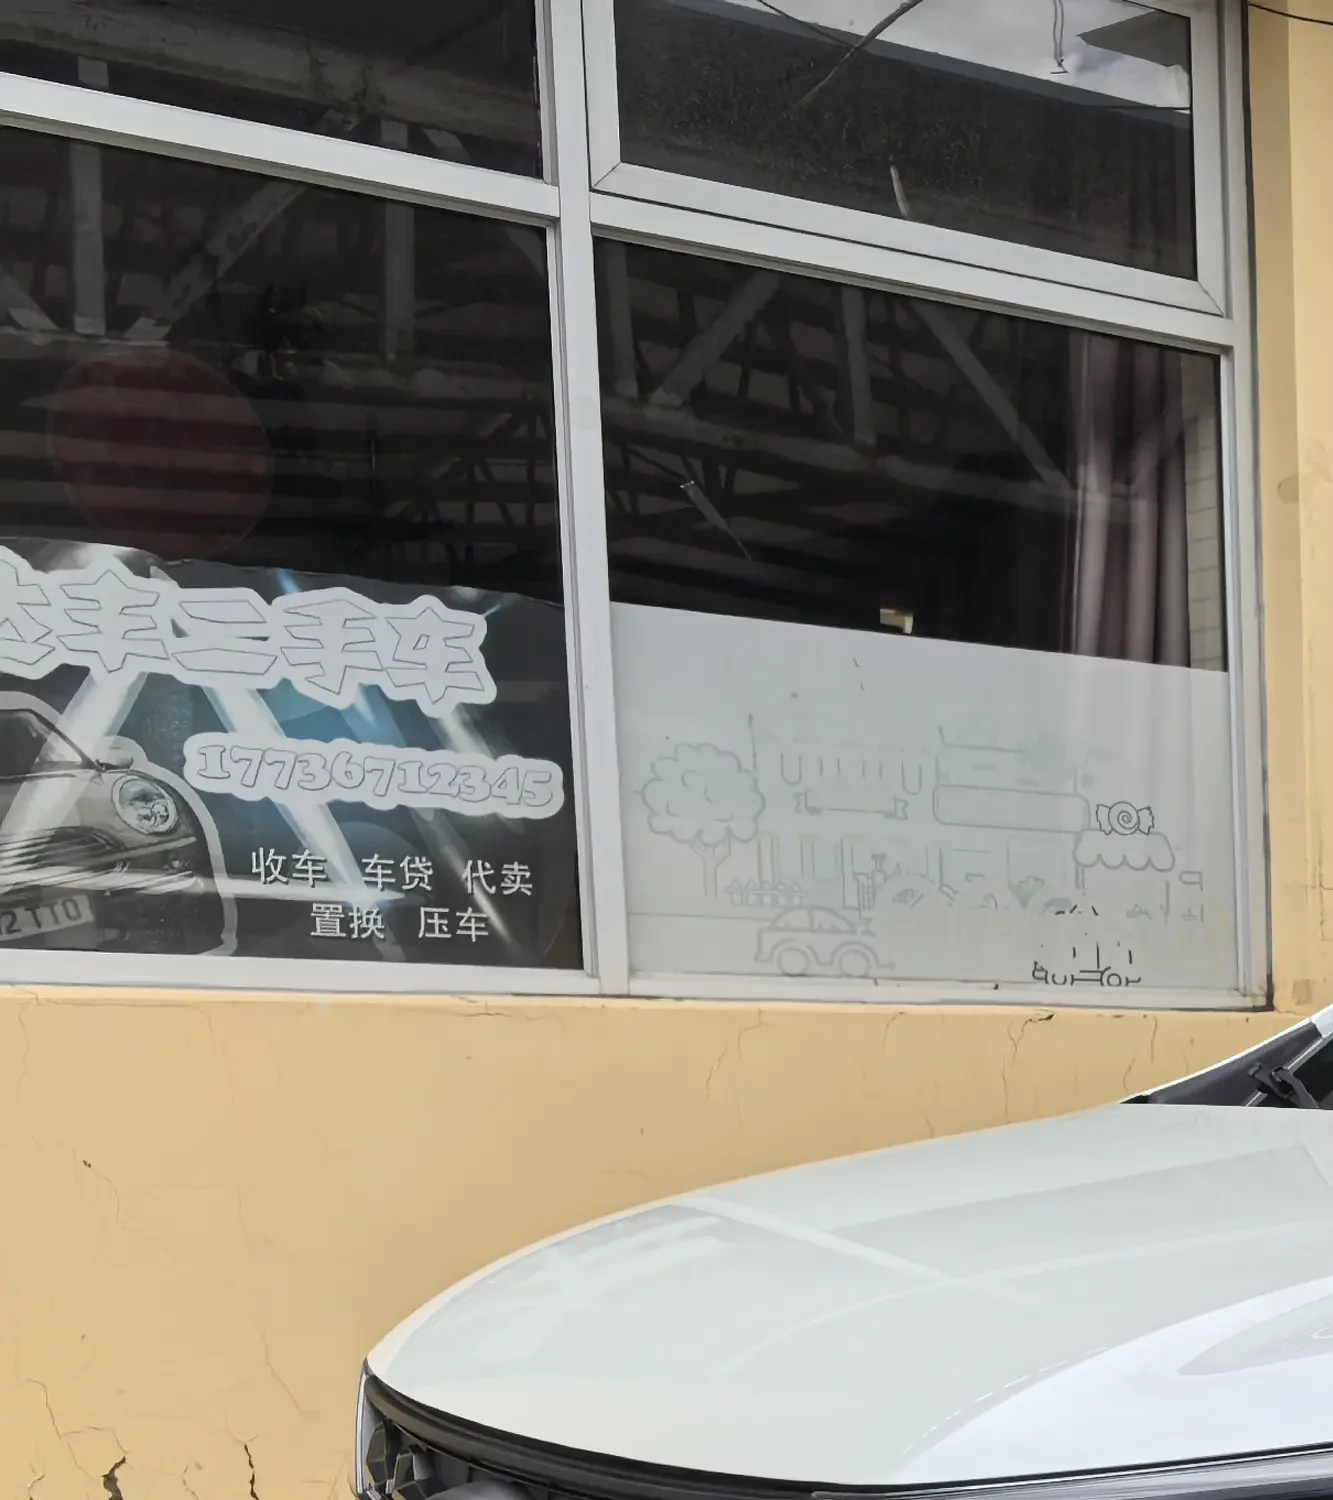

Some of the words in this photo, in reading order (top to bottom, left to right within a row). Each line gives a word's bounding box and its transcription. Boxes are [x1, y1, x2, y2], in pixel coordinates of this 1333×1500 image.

[197, 744, 553, 807] 17736712345
[250, 847, 328, 888] 收车
[361, 852, 434, 892] 车贷
[461, 859, 533, 897] 代卖
[309, 902, 386, 940] 置换
[417, 906, 491, 943] 压车
